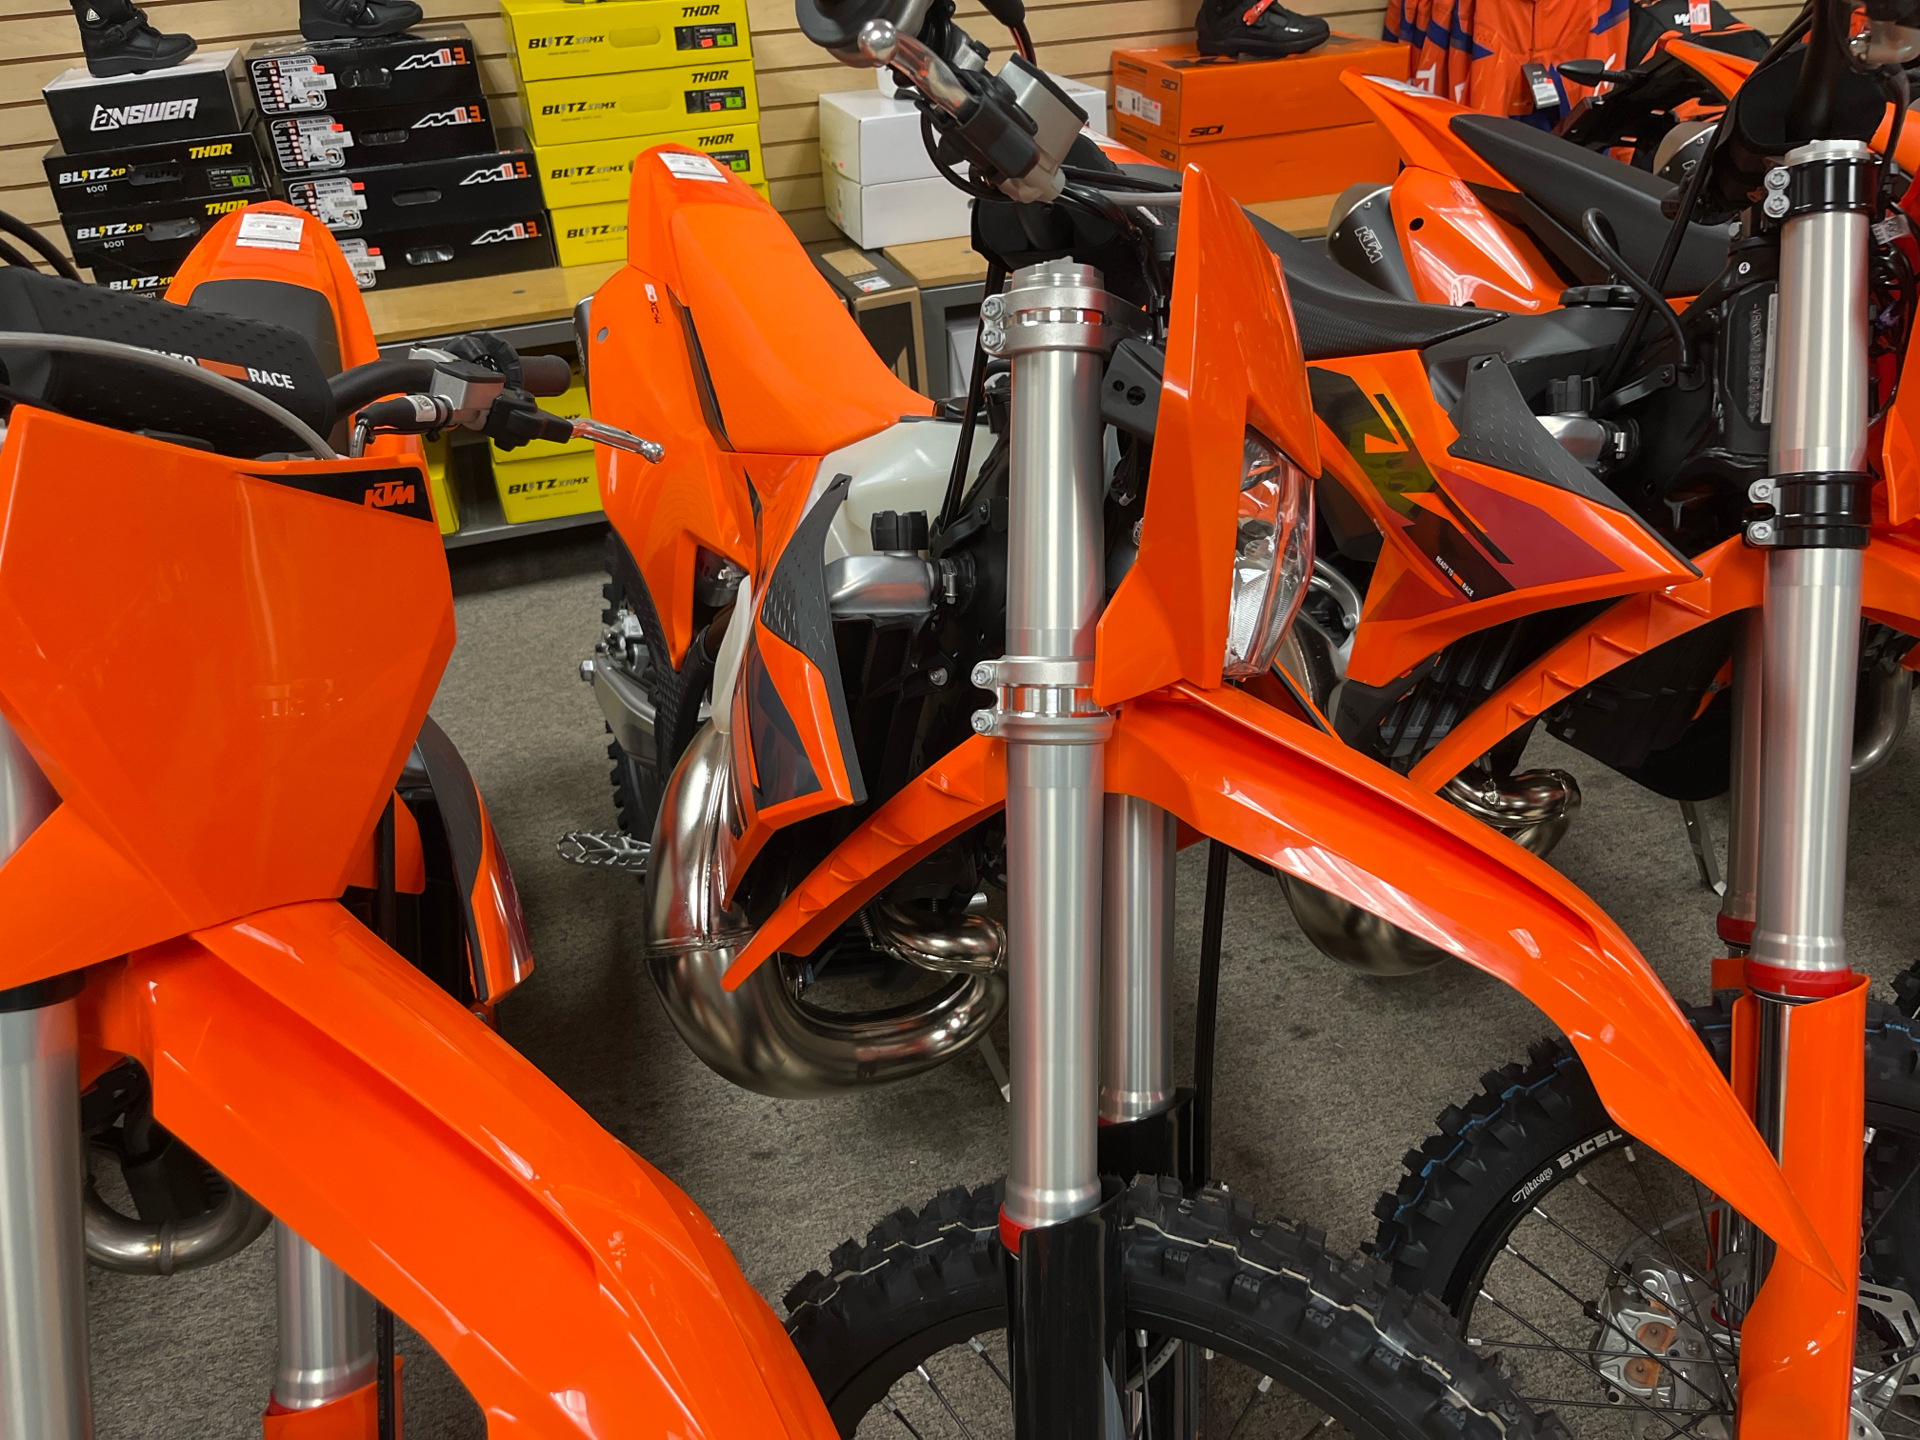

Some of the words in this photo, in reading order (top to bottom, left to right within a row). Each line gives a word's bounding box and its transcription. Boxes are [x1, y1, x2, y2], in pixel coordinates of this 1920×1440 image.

[682, 5, 720, 18] THOR
[691, 70, 729, 84] THOR
[698, 133, 735, 147] THOR
[189, 143, 233, 160] THOR
[59, 167, 110, 185] BLITZ
[86, 184, 108, 194] BOOT
[77, 222, 127, 240] BLITZ
[103, 240, 125, 249] BOOT
[1354, 226, 1383, 264] KTM
[109, 275, 159, 291] BLITZ
[248, 367, 296, 390] RACE
[364, 481, 414, 507] KTM
[508, 479, 557, 495] BLITZ
[1556, 1129, 1623, 1170] EXCEL
[1511, 1167, 1554, 1203] Takasago
